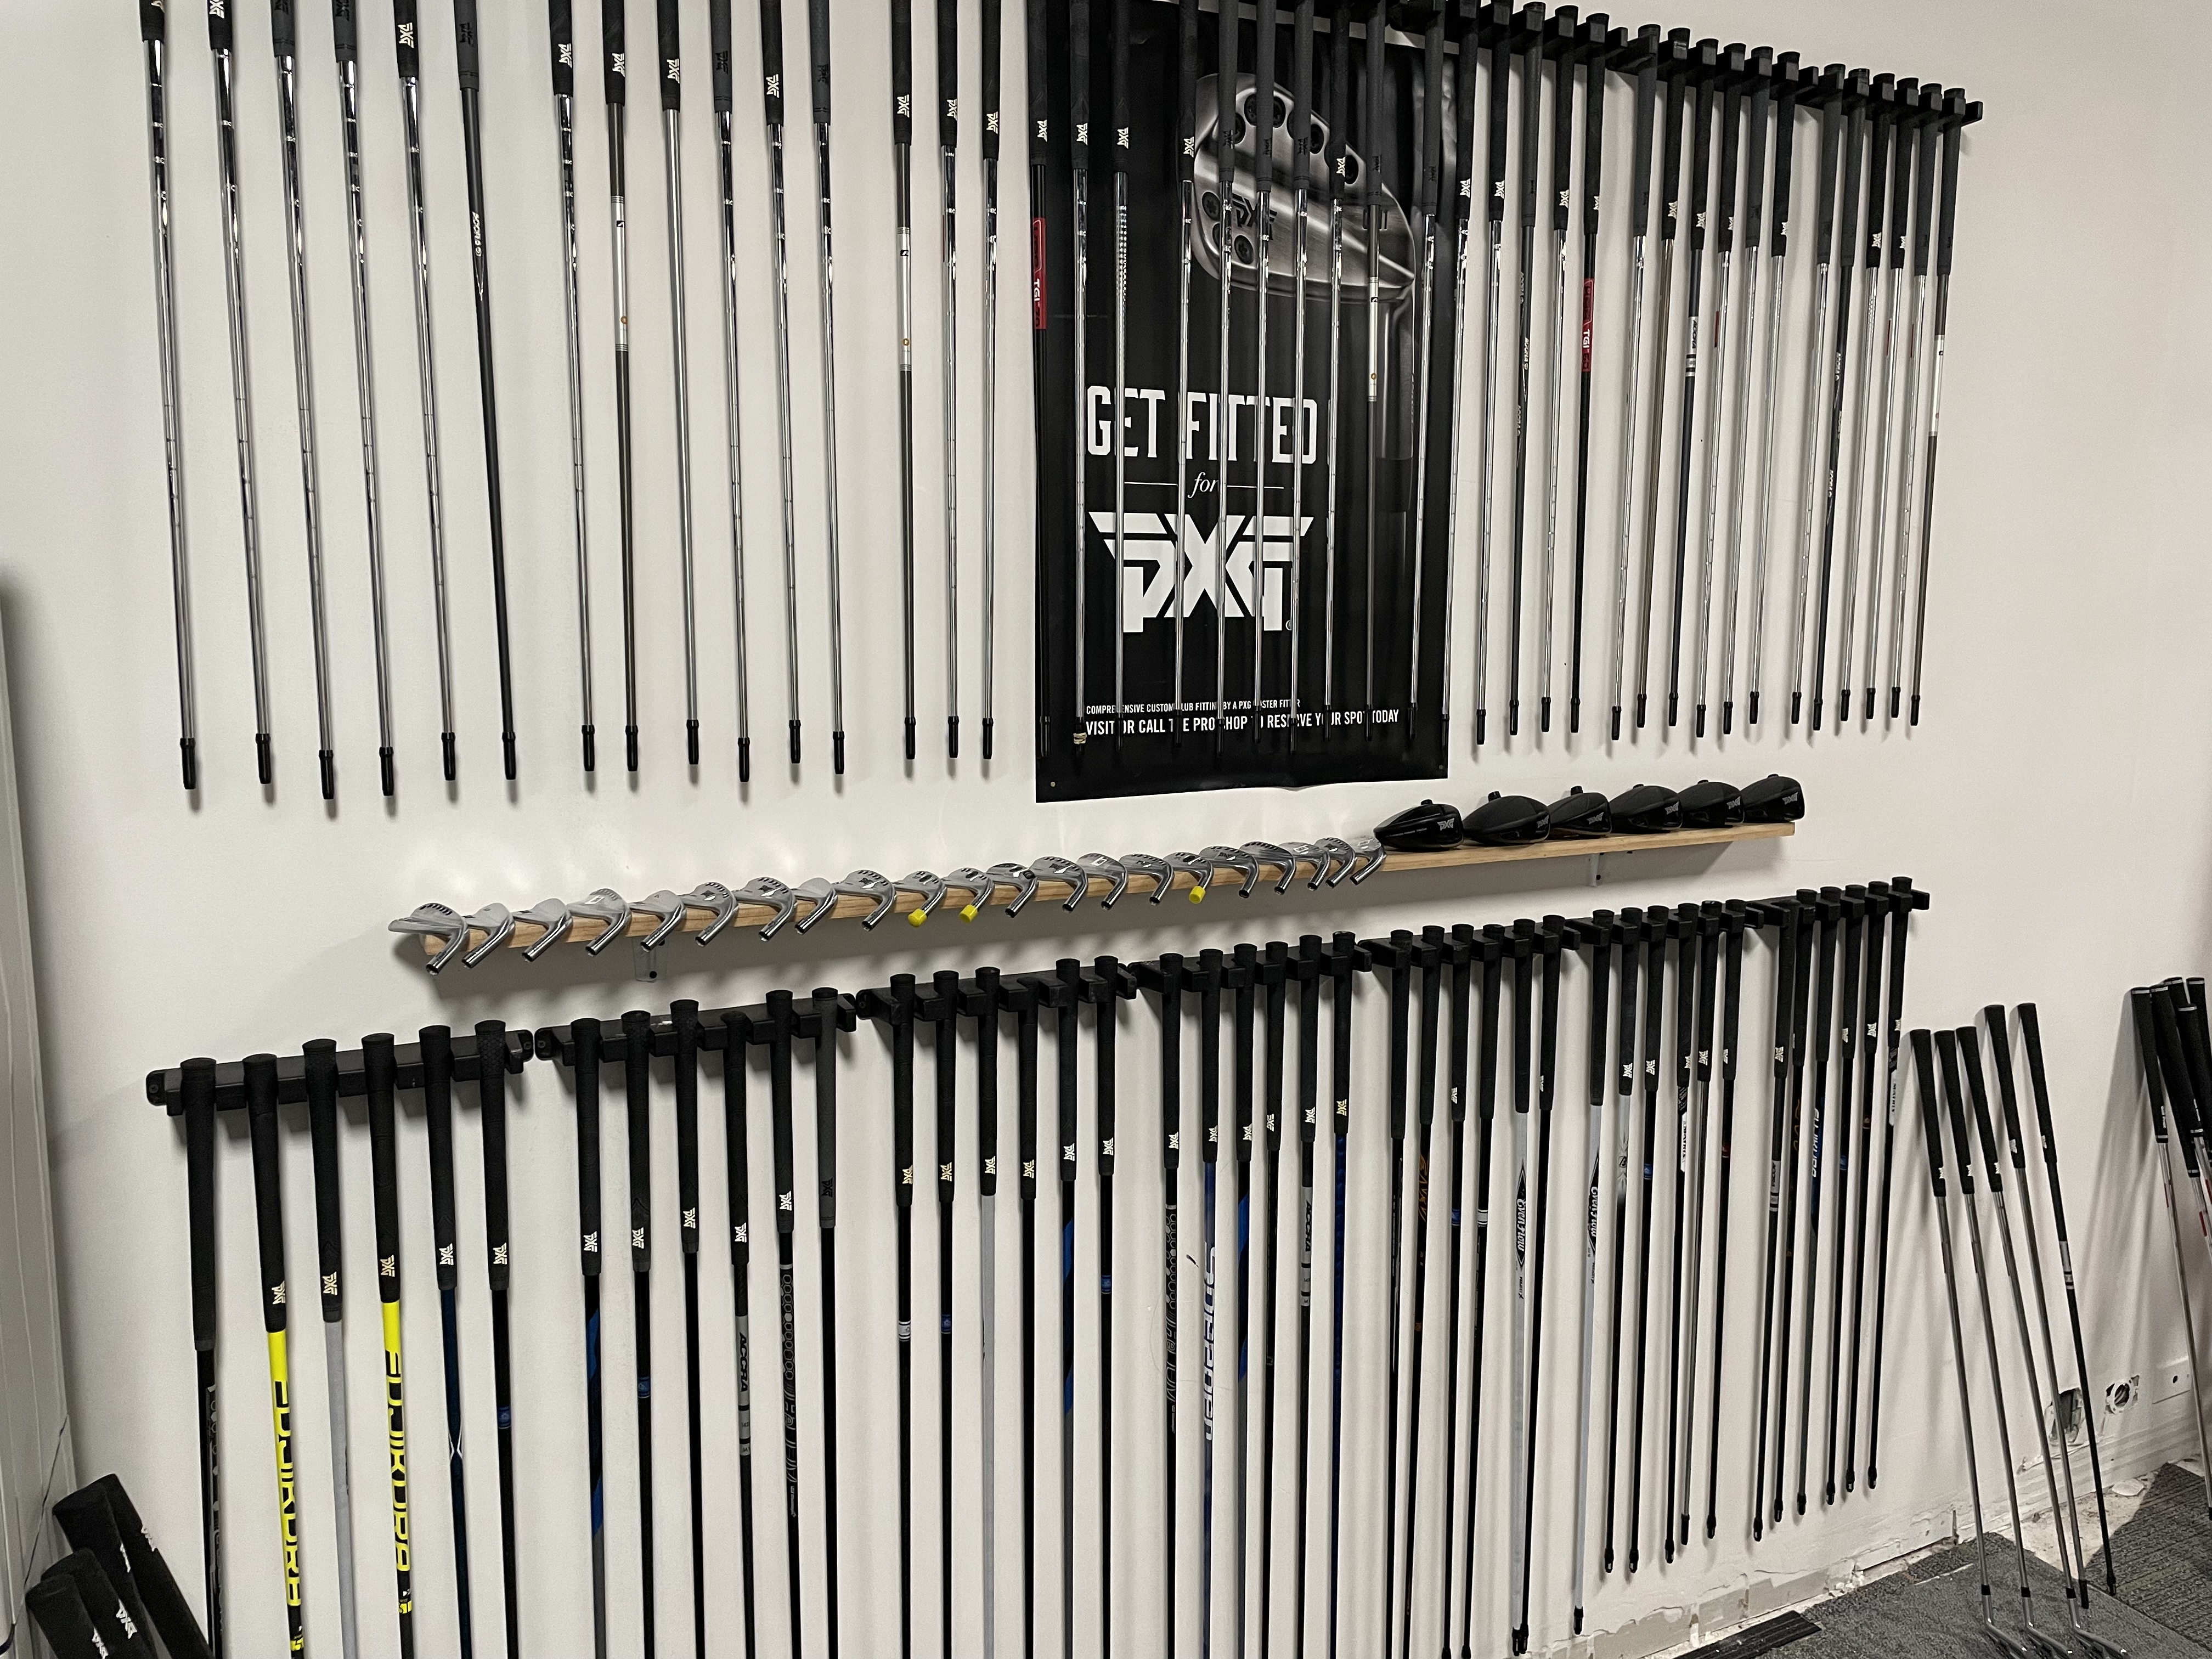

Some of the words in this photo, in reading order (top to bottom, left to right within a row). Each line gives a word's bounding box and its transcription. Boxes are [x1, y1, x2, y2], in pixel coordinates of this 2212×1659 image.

[210, 0, 225, 18] XG
[398, 22, 414, 48] PXG
[558, 43, 572, 68] PXG
[612, 53, 625, 77] PXG
[667, 58, 680, 83] PXG
[766, 74, 780, 98] PXG
[897, 94, 909, 117] PXG
[947, 99, 957, 120] PXG
[986, 111, 998, 134] PXG
[1037, 120, 1047, 142] PXG
[1076, 123, 1087, 145] PXG
[1117, 127, 1128, 149] PXG
[1183, 137, 1194, 158] PXG
[1336, 157, 1346, 177] PXG
[1460, 178, 1471, 198] PXG
[1494, 180, 1505, 199] PXG
[1560, 189, 1568, 208] PXG
[1668, 201, 1678, 219] PXG
[1696, 212, 1706, 229] PXG
[1872, 232, 1882, 248] PXG
[1087, 386, 1165, 458] GET
[1186, 392, 1317, 464] FITTED
[1187, 472, 1219, 499] for
[1088, 511, 1314, 633] PXG
[1086, 704, 1144, 714] COMPREENSIVE
[1147, 703, 1175, 713] CUSTOM
[1181, 702, 1193, 712] LUB
[1195, 701, 1218, 711] FITTIN
[1223, 701, 1231, 710] BY
[1232, 701, 1237, 709] A
[1239, 700, 1251, 709] PXG
[1279, 698, 1300, 708] FITR
[1086, 720, 1115, 735] VISIT
[1138, 718, 1166, 733] CALL
[1169, 717, 1190, 732] TE
[1193, 716, 1216, 731] PRO
[1223, 715, 1248, 730] HOP
[1344, 709, 1364, 725] SPO
[1665, 801, 1680, 816] PXG
[1726, 797, 1741, 811] PXG
[1782, 792, 1799, 806] PXG
[1438, 817, 1454, 831] PXG
[1537, 815, 1549, 828] PXG
[1587, 812, 1604, 826] PXG
[1867, 1022, 1877, 1037] PXG
[1699, 1049, 1708, 1065] PXG
[1775, 1046, 1784, 1063] PXG
[1623, 1063, 1633, 1079] PXG
[1646, 1059, 1655, 1075] PXG
[1305, 1107, 1315, 1125] PXG
[1336, 1098, 1347, 1117] PXG
[1169, 1132, 1178, 1150] PXG
[1208, 1125, 1217, 1143] PXG
[1243, 1123, 1252, 1141] PXG
[1064, 1143, 1074, 1161] PXG
[1103, 1137, 1114, 1156] PXG
[902, 1164, 913, 1184] PXG
[940, 1161, 952, 1182] PXG
[985, 1155, 996, 1175] PXG
[1023, 1159, 1034, 1179] PXG
[780, 1191, 792, 1211] PXG
[683, 1207, 696, 1229] PXG
[583, 1231, 597, 1252] PXG
[632, 1227, 645, 1249] PXG
[735, 1222, 747, 1243] PXG
[439, 1243, 453, 1266] PXG
[493, 1242, 507, 1265] PXG
[380, 1255, 395, 1278] PXG
[272, 1280, 285, 1305] PXG
[323, 1271, 337, 1295] PXG
[739, 1332, 749, 1393] ACCRA
[385, 1349, 409, 1569] FUJIKURA
[276, 1381, 301, 1605] FUJIKURA
